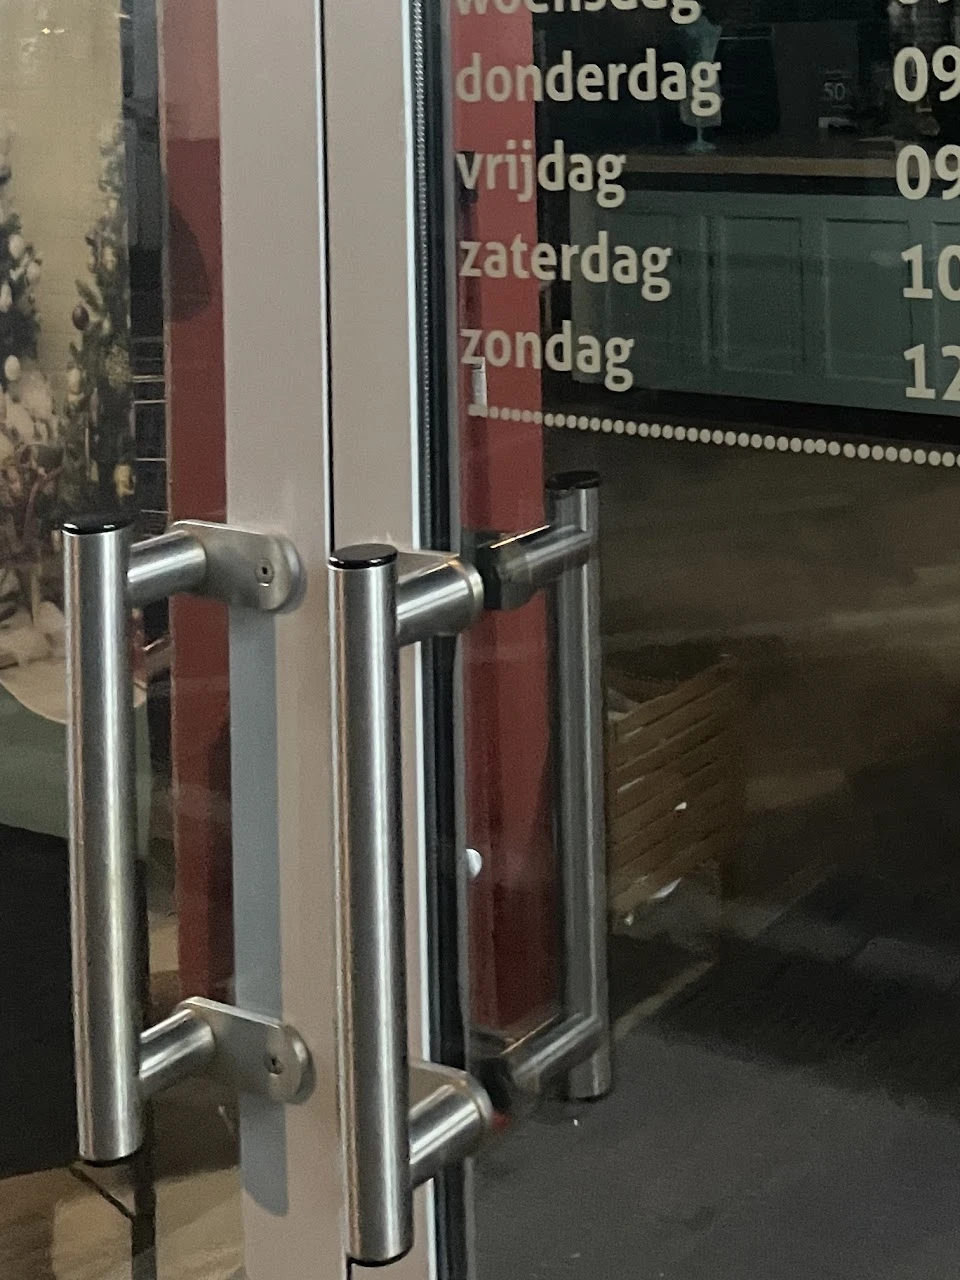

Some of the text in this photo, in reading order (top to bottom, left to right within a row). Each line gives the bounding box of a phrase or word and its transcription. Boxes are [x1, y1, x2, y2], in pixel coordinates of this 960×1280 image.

[455, 48, 722, 117] donderdag
[456, 140, 627, 208] vrijdag
[459, 233, 673, 301] zaterdag
[460, 320, 635, 391] zondag
